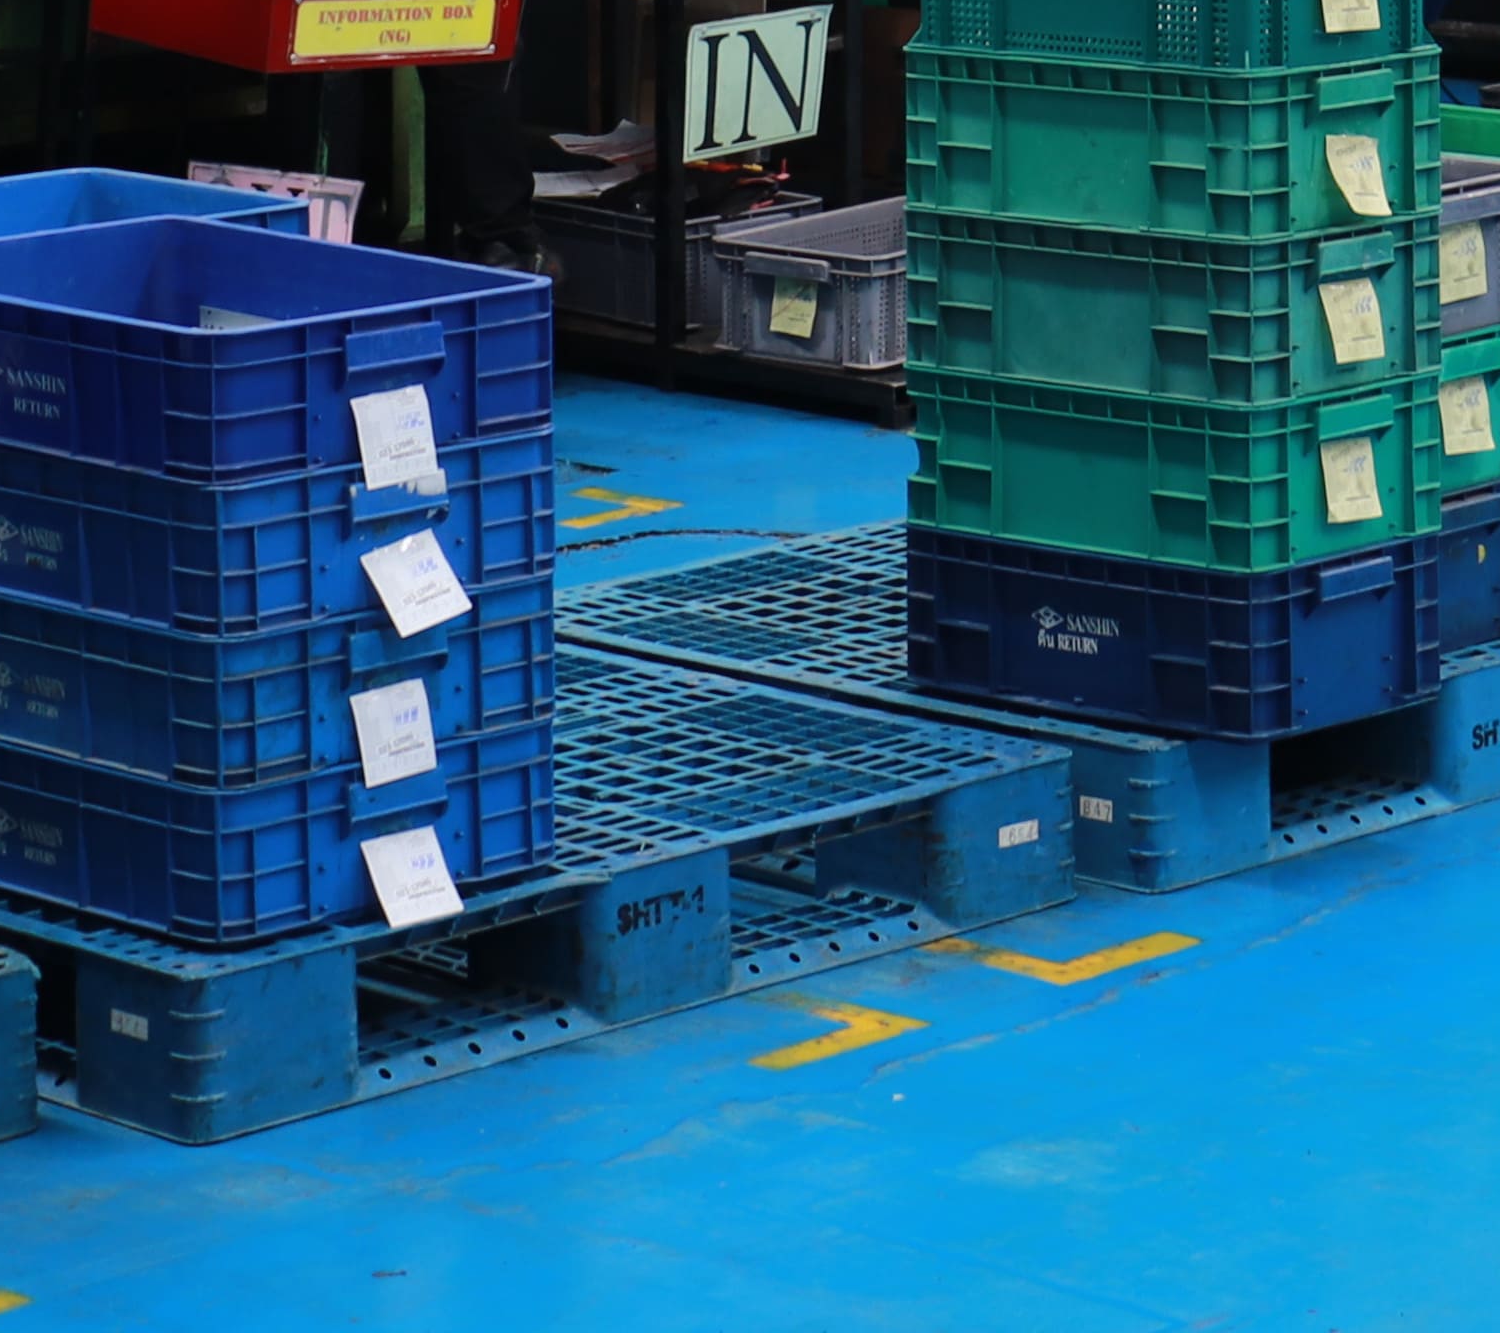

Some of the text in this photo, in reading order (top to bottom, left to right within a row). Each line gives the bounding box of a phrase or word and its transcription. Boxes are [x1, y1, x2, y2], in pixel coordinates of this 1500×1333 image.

[318, 3, 474, 25] INFORMATION BOX
[379, 29, 411, 46] (NG)
[694, 19, 822, 152] IN
[6, 367, 67, 396] SANSHIN
[13, 396, 61, 419] RETURN
[1065, 612, 1120, 638] SANSHIN
[1057, 632, 1098, 655] RETURN
